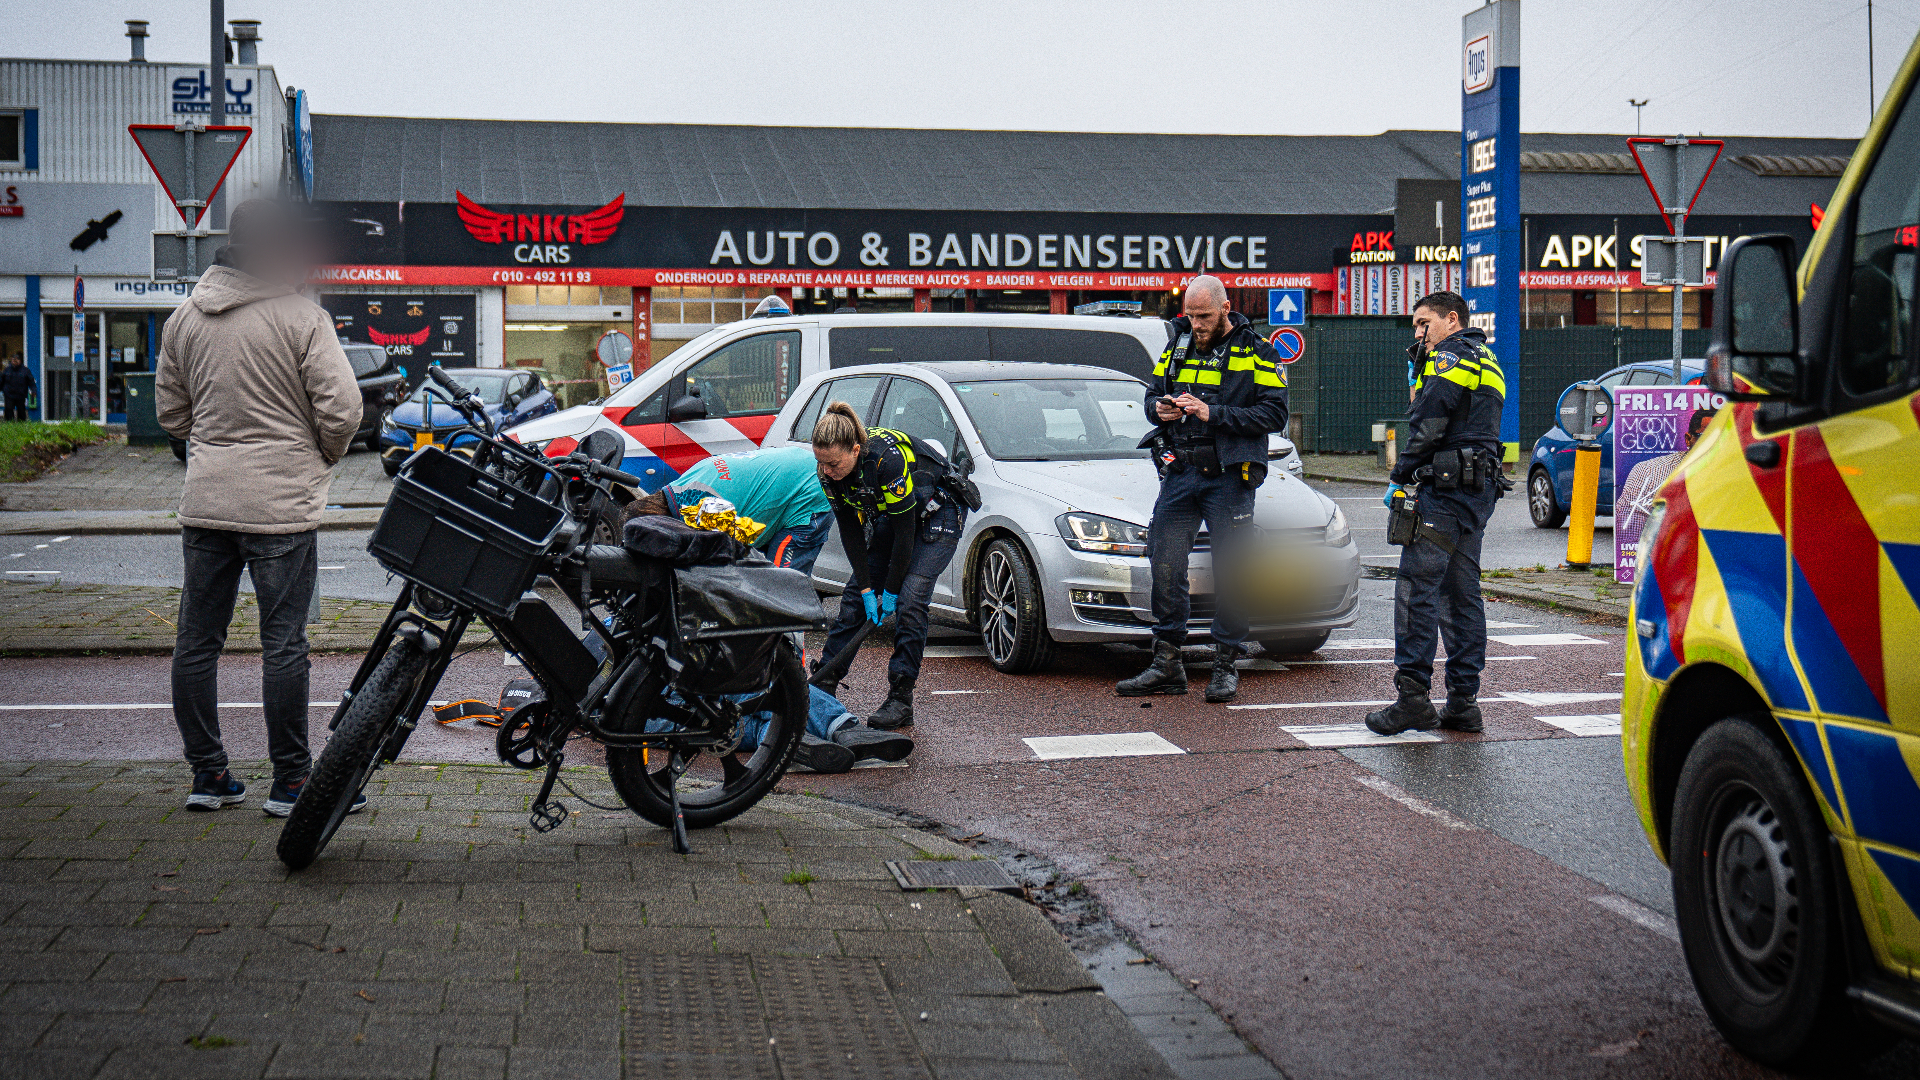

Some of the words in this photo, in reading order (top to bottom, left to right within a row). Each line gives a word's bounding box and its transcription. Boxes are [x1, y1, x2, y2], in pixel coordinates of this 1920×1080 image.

[1468, 49, 1485, 81] Argos
[0, 186, 18, 204] S
[1466, 183, 1480, 197] Super
[1481, 181, 1492, 193] Plus
[710, 230, 839, 266] AUTO
[860, 231, 889, 266] &
[908, 232, 1268, 269] BANDENSERVICE
[1351, 231, 1394, 252] APK
[1466, 242, 1481, 255] Diesel
[514, 244, 571, 264] CARS
[1350, 250, 1396, 263] STATION
[1540, 235, 1617, 267] APK
[501, 271, 523, 282] 010
[534, 271, 556, 282] 492
[560, 271, 573, 283] 11
[576, 271, 591, 283] 93
[655, 271, 734, 284] ONDERHOUD
[737, 272, 746, 284] &
[749, 272, 812, 285] REPARATIE
[815, 273, 842, 285] AAN
[845, 273, 872, 285] ALLE
[875, 273, 923, 285] MERKEN
[926, 274, 970, 286] AUTO'S
[986, 275, 1034, 286] BANDEN
[1049, 275, 1093, 287] VELGEN
[1109, 276, 1164, 287] UITLIJNEN
[1235, 276, 1312, 287] CARCLEANING
[1434, 266, 1443, 293] VREDE
[1529, 275, 1572, 286] ZONDER
[1575, 276, 1629, 286] AFSPRAAK
[386, 345, 413, 356] CARS
[780, 345, 788, 400] STATION
[1620, 393, 1660, 411] FRI.
[1664, 392, 1689, 411] 14
[1693, 392, 1727, 411] NO
[1621, 417, 1677, 434] MOON
[1620, 432, 1678, 450] GLOW
